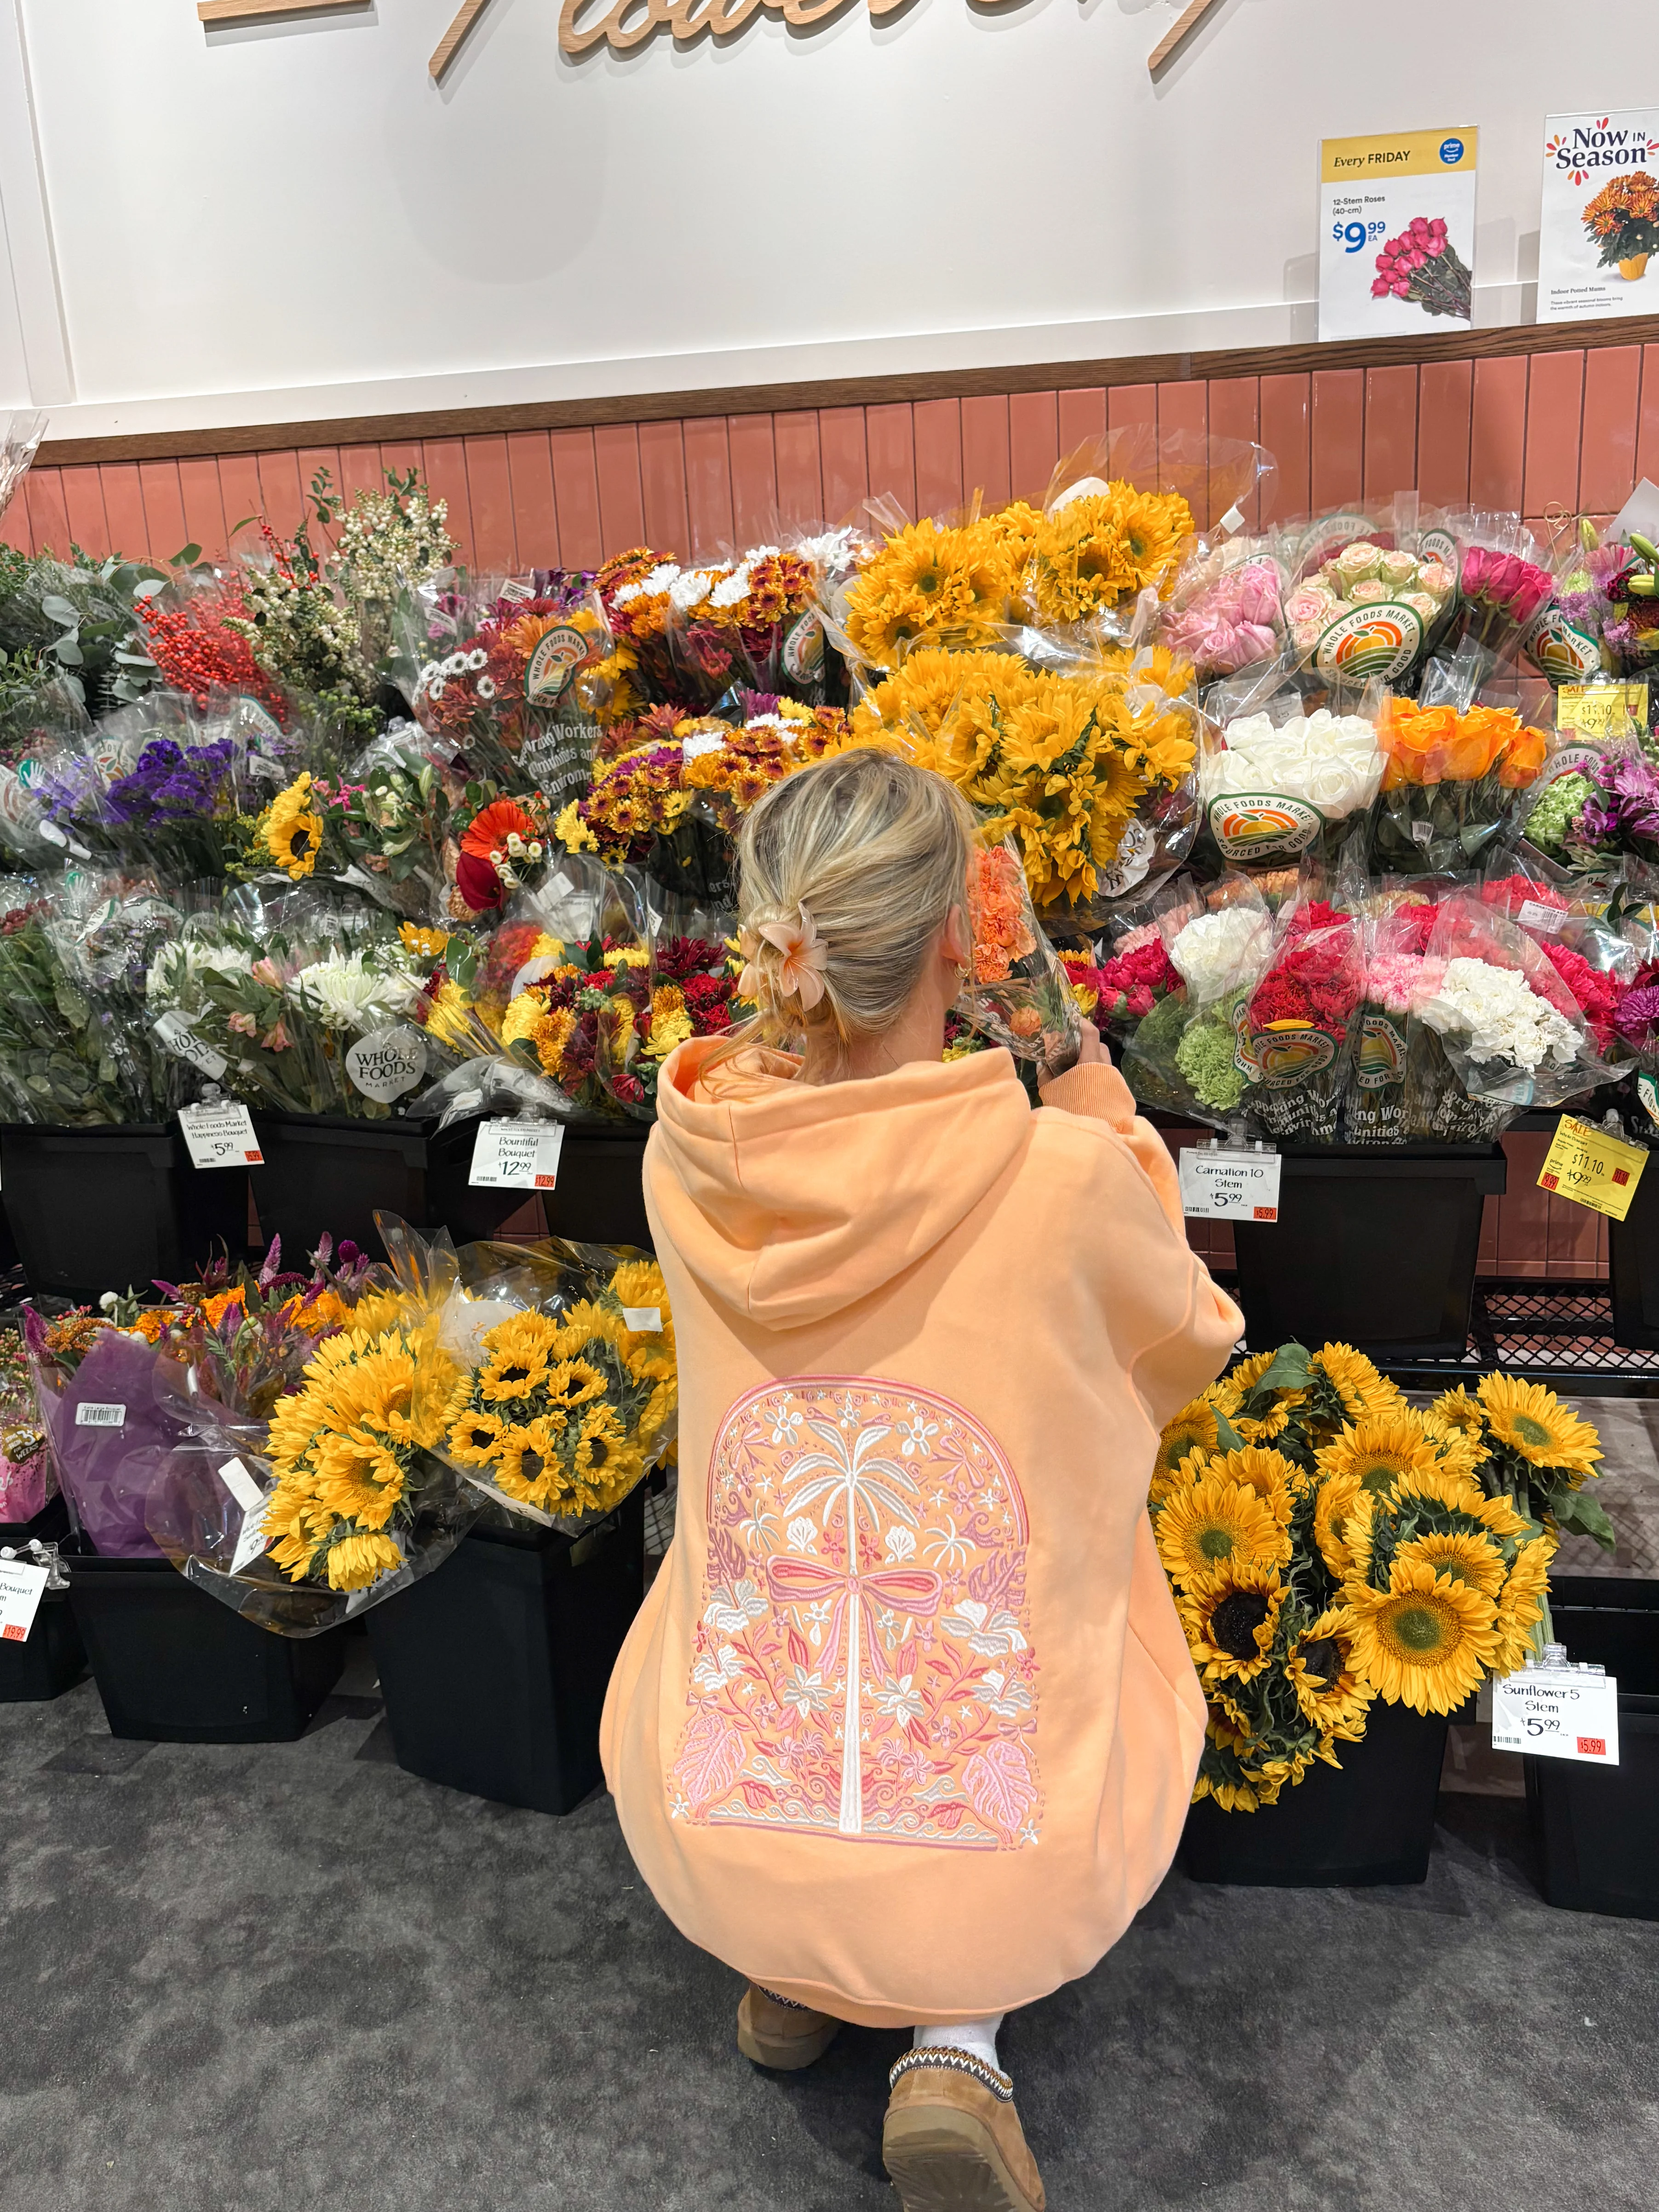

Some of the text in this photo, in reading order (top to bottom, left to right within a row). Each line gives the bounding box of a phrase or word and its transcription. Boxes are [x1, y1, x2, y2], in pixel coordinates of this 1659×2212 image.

[1572, 127, 1645, 149] Now IN
[1333, 150, 1411, 167] Every FRIDAY
[1556, 147, 1647, 169] Season
[1332, 206, 1362, 216] (40-cm)
[1322, 609, 1415, 655] WHOLE FOODS MARKET
[1563, 626, 1593, 655] MARKET
[788, 632, 802, 657] WHOLE
[532, 649, 547, 680] WHOLE
[545, 634, 565, 650] FOODS
[1392, 649, 1412, 673] GOOD
[551, 723, 603, 741] Workers
[1213, 804, 1232, 823] WHOLE
[1233, 799, 1271, 809] FOODS
[1217, 838, 1260, 856] SOURCED
[1288, 828, 1312, 848] GOOD
[1365, 1019, 1389, 1029] OODS
[1267, 1034, 1296, 1044] FOODS
[1300, 1034, 1329, 1049] MARKET
[355, 1046, 419, 1066] WHOLE
[359, 1062, 416, 1080] FOODS
[1296, 1070, 1310, 1082] FOR
[1311, 1054, 1328, 1069] GOOD
[366, 1076, 406, 1088] MARKET
[1374, 1074, 1390, 1085] FOR
[223, 1128, 248, 1138] Bouquet
[1564, 1119, 1592, 1137] SALE
[499, 1137, 539, 1147] Bountiful
[498, 1148, 535, 1158] Bouquet
[1550, 1158, 1563, 1167] prime
[1572, 1153, 1604, 1175] $11.10
[1195, 1165, 1264, 1178] Carnation 10
[535, 1175, 555, 1186] $12.99
[1215, 1178, 1242, 1189] Stem
[1256, 1208, 1274, 1218] $5.99
[16, 1442, 39, 1461] WEEKS
[0, 1582, 33, 1595] Bouquet
[1503, 1683, 1580, 1700] Sunflower 5
[1525, 1700, 1559, 1713] Stem
[1580, 1739, 1602, 1753] $5.99
